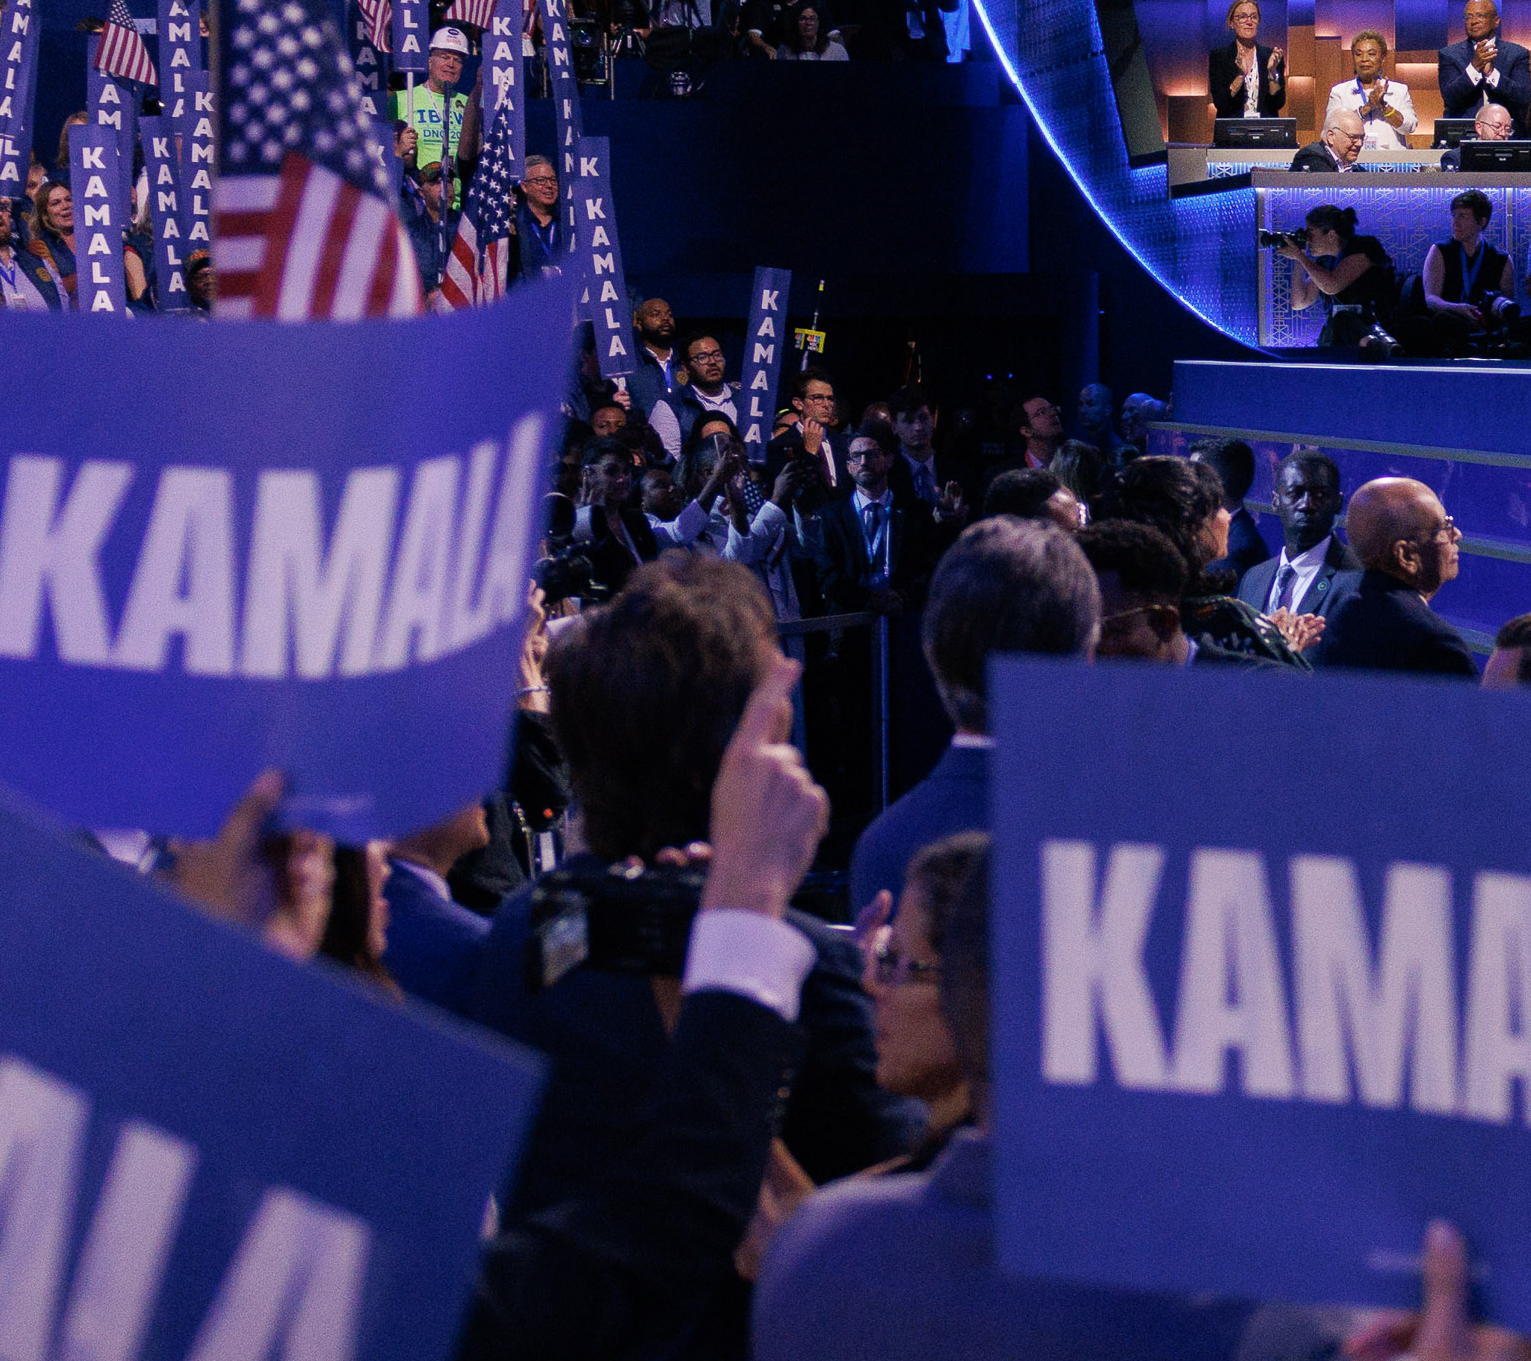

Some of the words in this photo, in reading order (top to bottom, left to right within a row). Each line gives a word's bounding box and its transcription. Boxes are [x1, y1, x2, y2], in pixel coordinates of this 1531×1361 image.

[355, 21, 379, 115] KAMA
[82, 146, 115, 313] KAMALA
[153, 137, 187, 293] KAMALA
[187, 91, 216, 241] KAMALA
[585, 197, 627, 357] KAMALA
[744, 289, 779, 444] KAMALA
